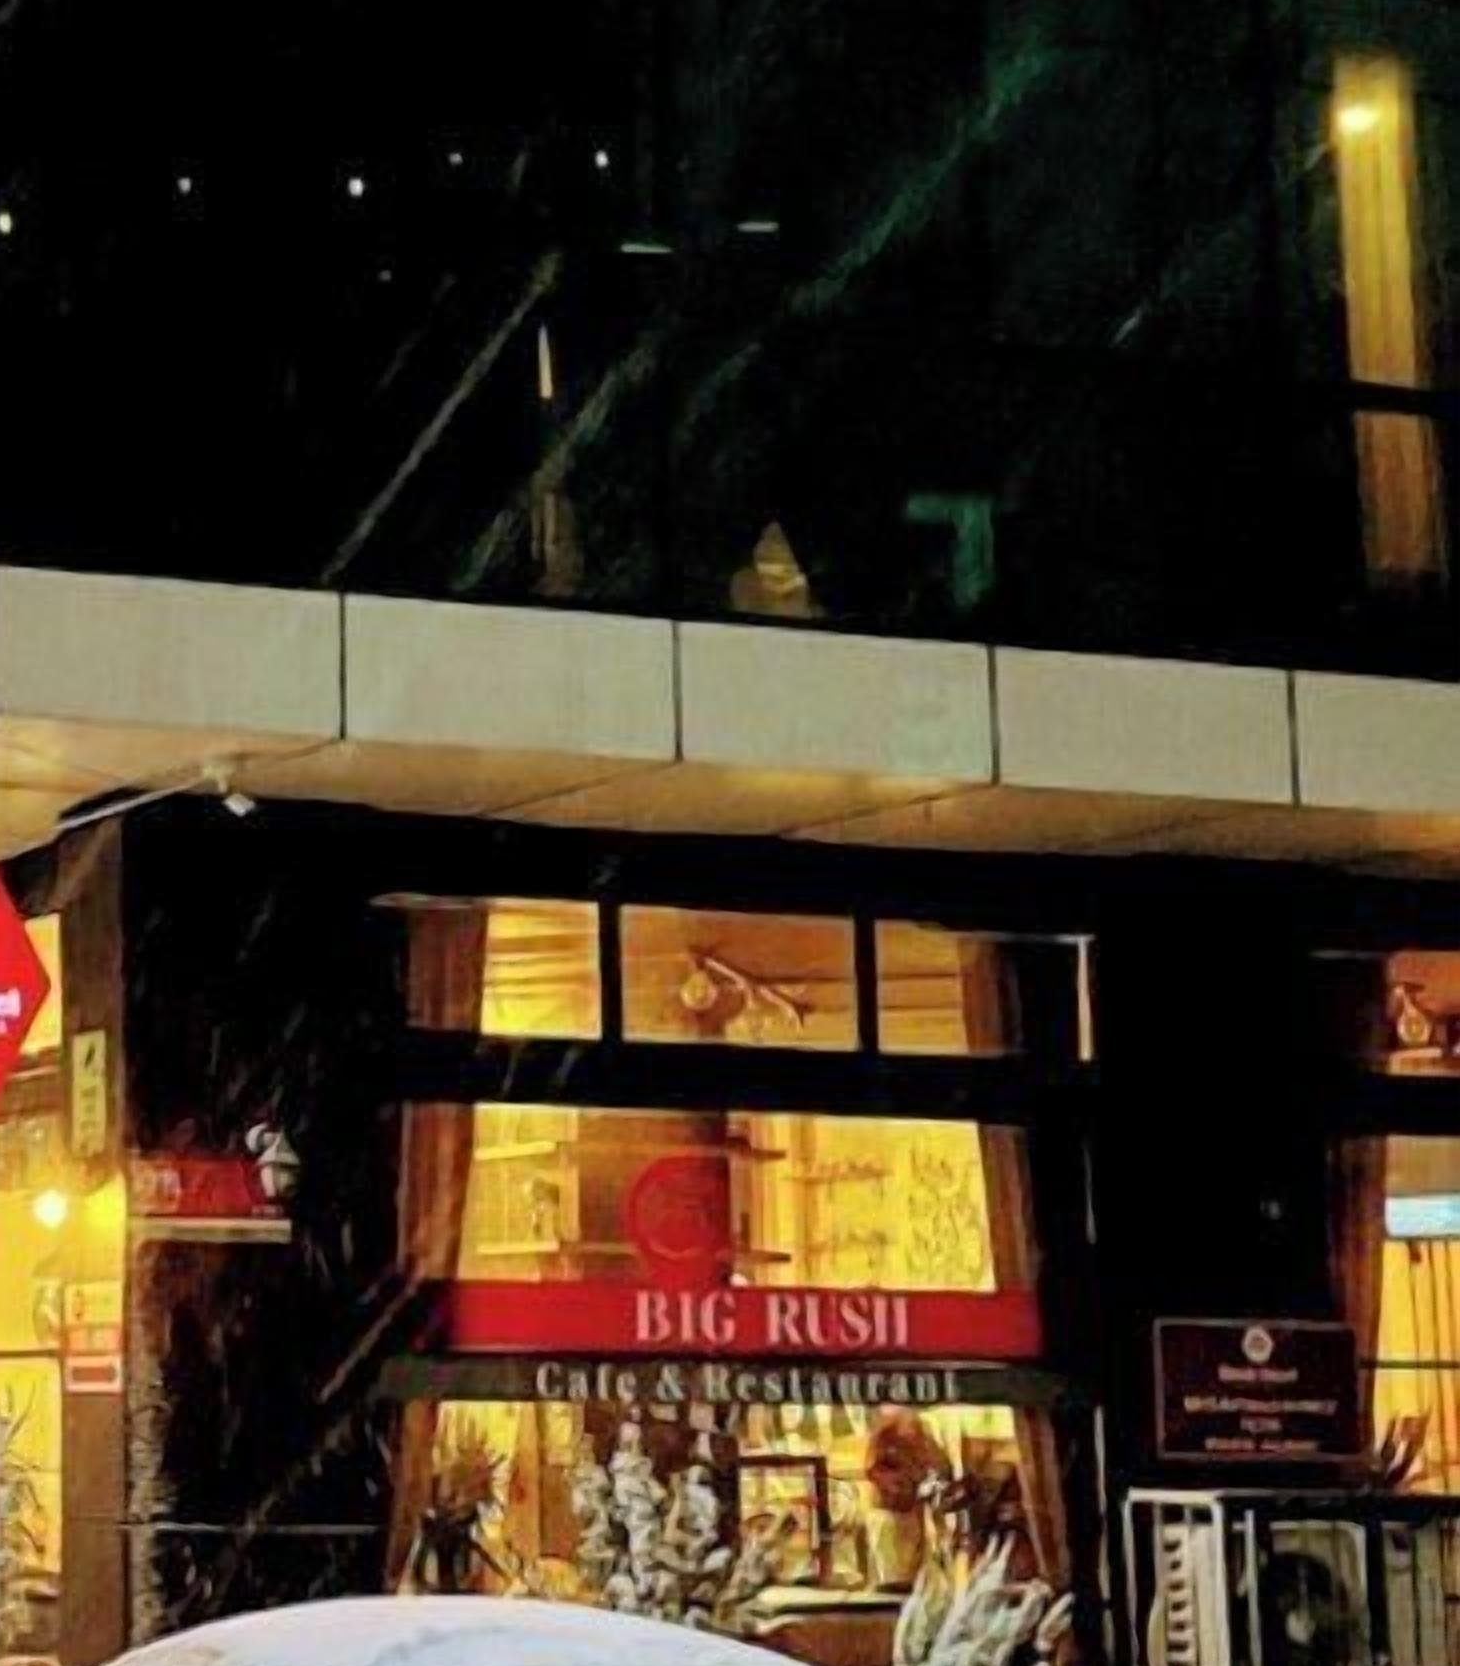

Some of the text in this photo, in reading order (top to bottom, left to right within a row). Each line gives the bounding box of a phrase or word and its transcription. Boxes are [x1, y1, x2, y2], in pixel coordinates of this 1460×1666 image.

[636, 1288, 910, 1348] BIG RUSH
[536, 1360, 638, 1403] Cafe
[703, 1362, 961, 1405] Restaurant
